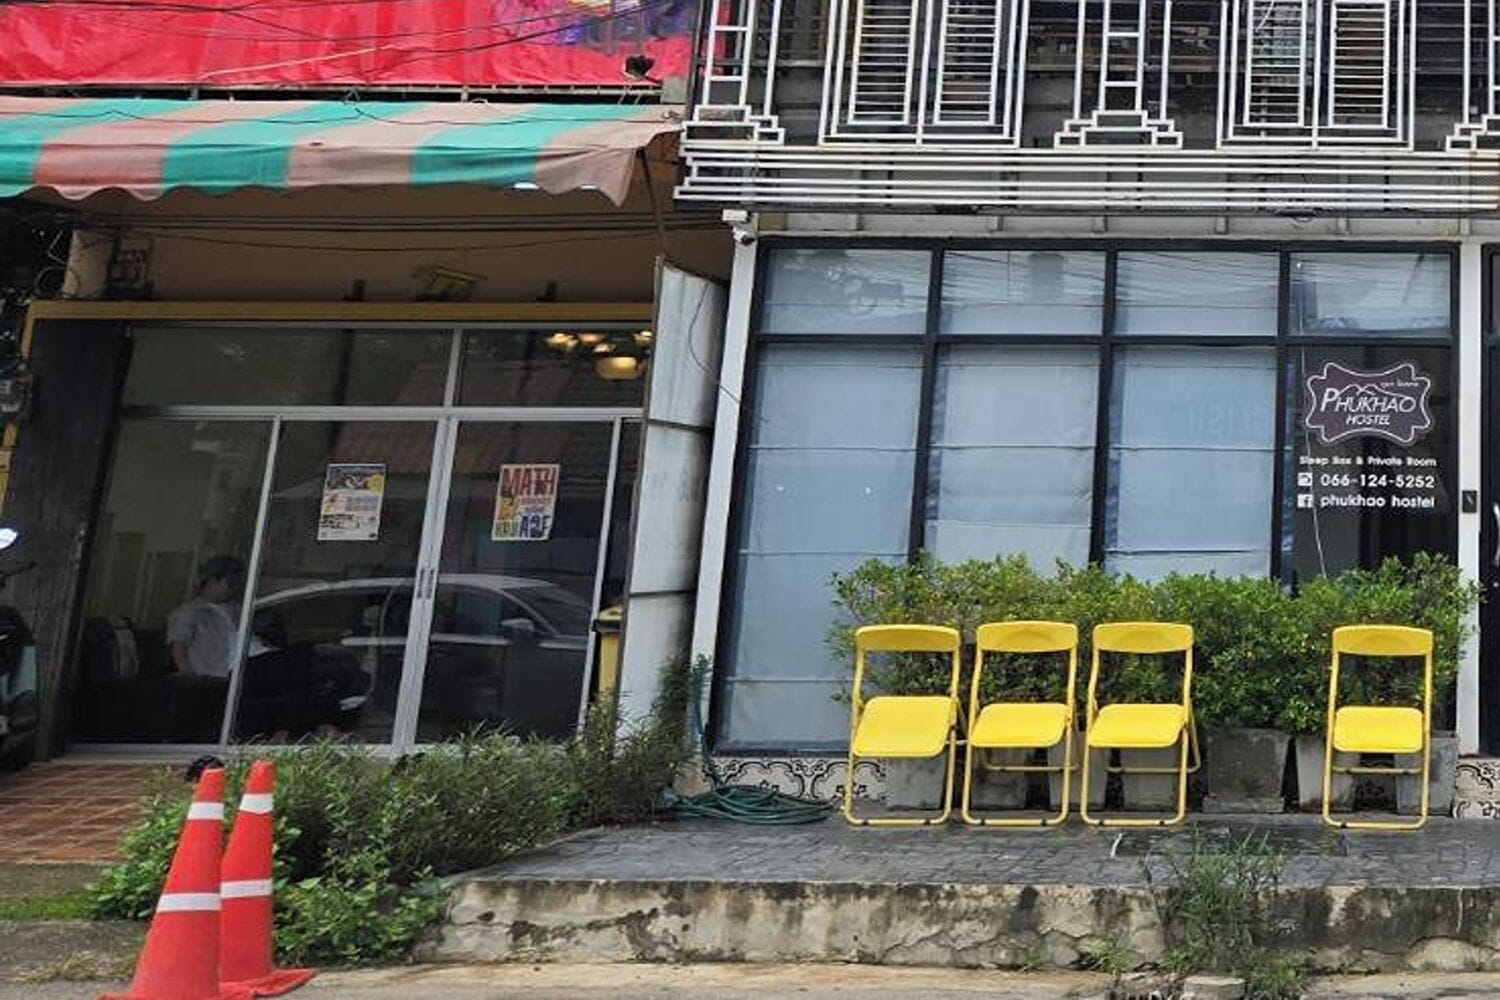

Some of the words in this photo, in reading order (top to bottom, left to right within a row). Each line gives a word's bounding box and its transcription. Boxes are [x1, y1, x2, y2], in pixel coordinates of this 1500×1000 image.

[1320, 388, 1416, 412] PHUKHAO
[1345, 414, 1391, 425] HOSTEL
[1320, 473, 1435, 488] 066-124-5252
[1320, 495, 1386, 508] phukhao
[1391, 496, 1435, 508] hostel
